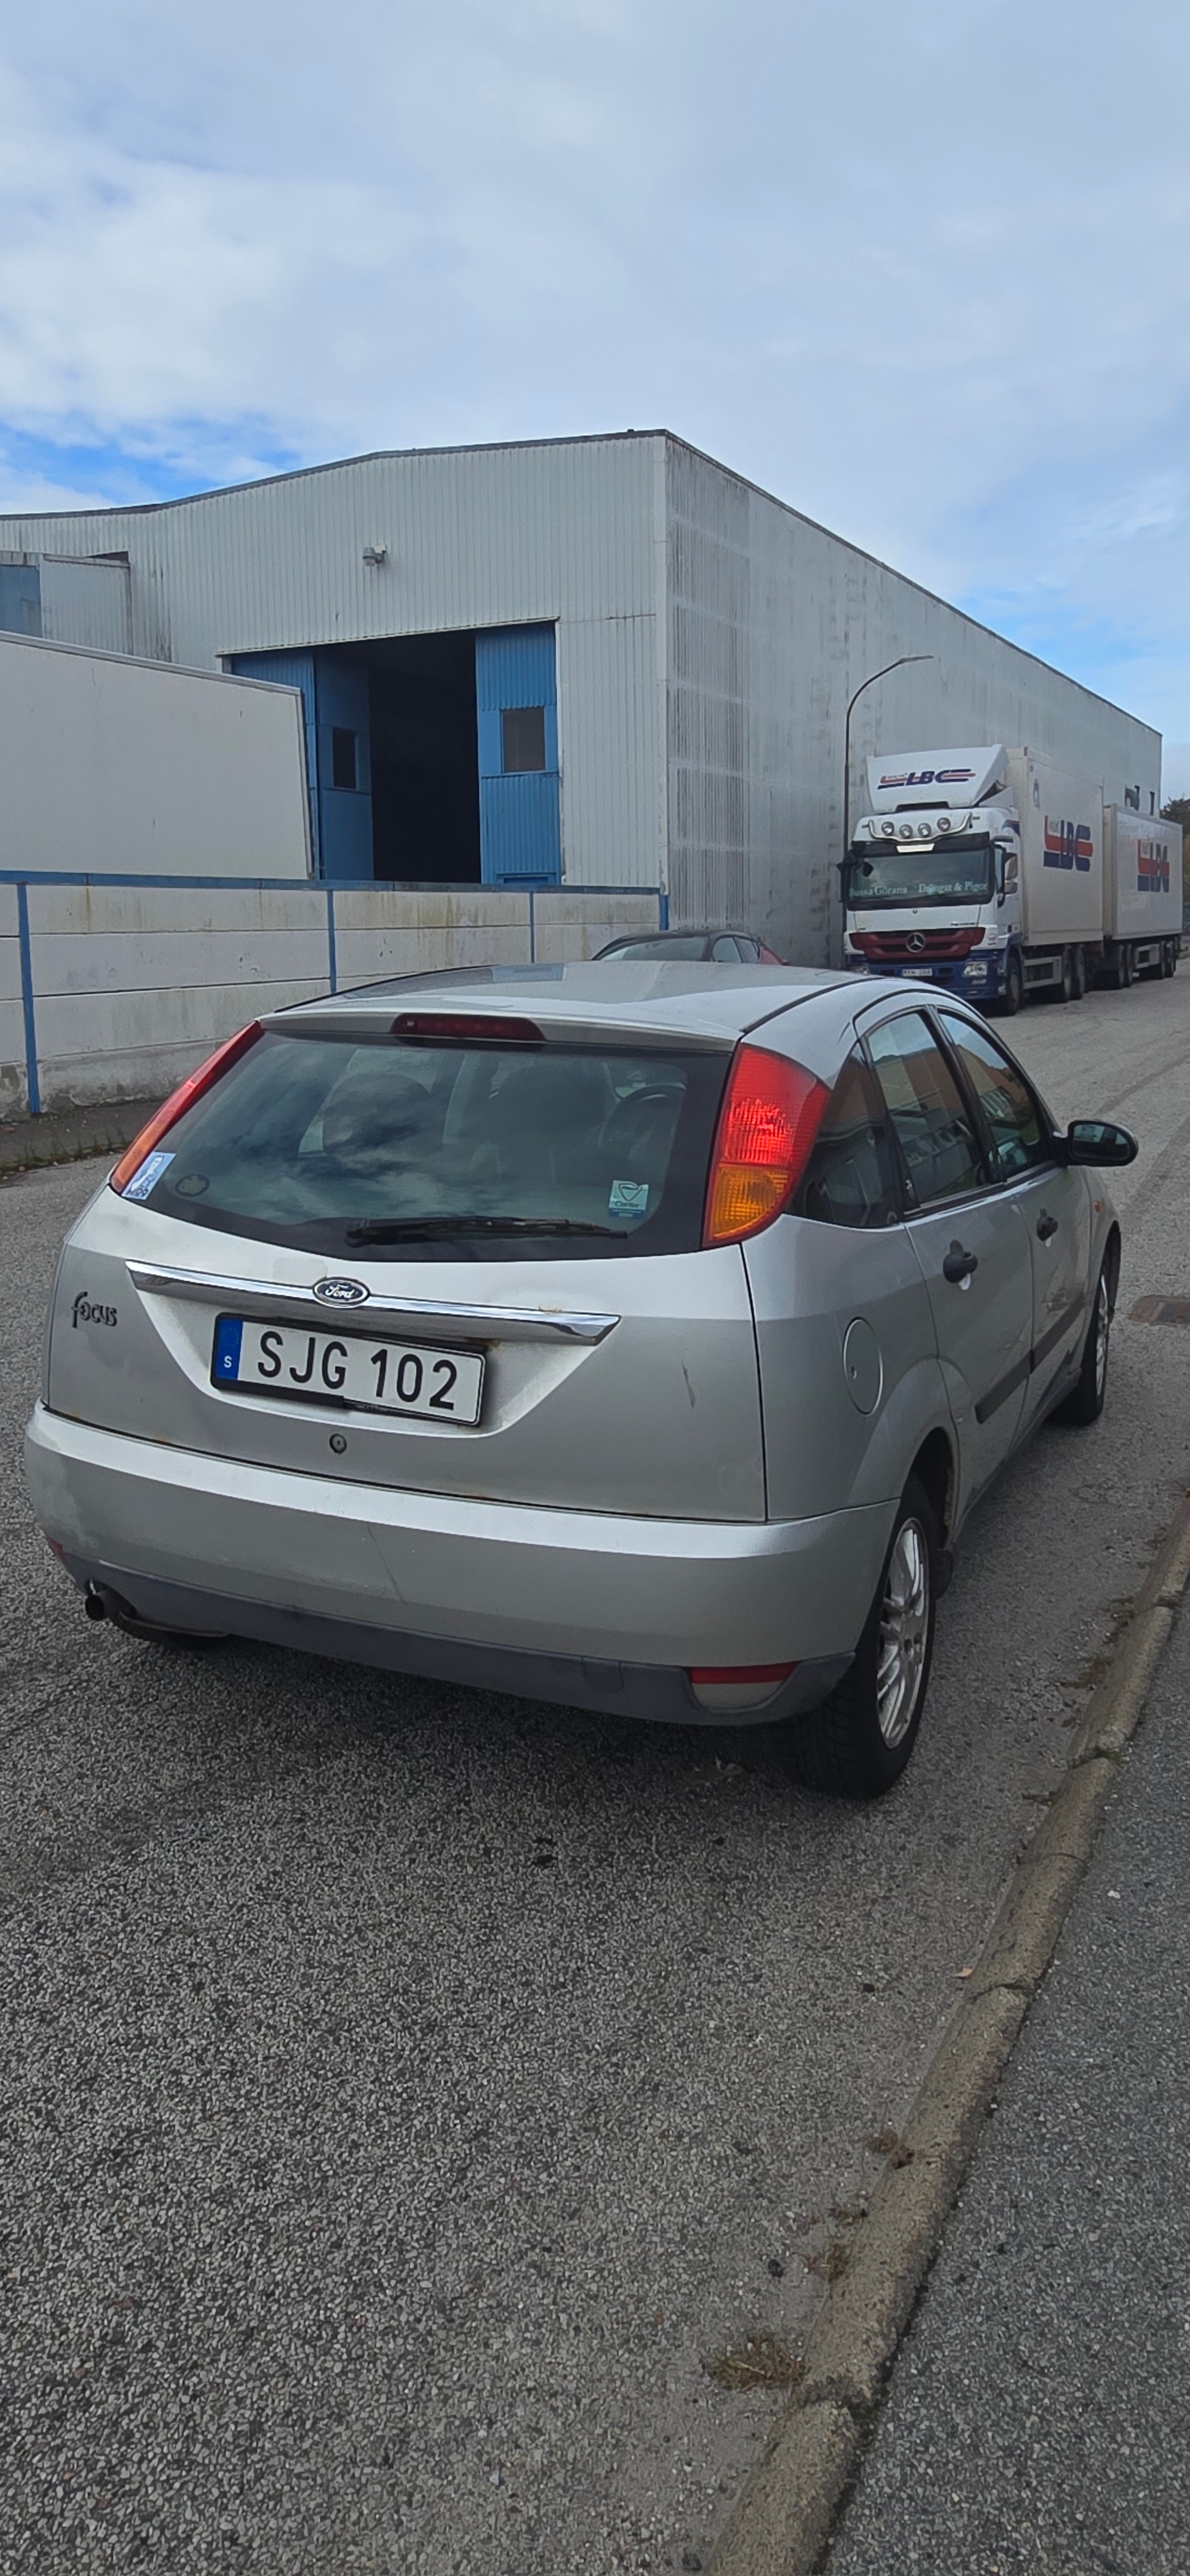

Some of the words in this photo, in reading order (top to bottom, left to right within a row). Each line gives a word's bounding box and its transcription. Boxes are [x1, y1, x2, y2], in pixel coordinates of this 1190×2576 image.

[905, 769, 976, 786] LBC
[954, 882, 962, 891] &
[325, 1283, 355, 1299] Ford
[223, 1355, 232, 1368] S
[258, 1331, 348, 1390] SJG
[370, 1349, 457, 1410] 102
